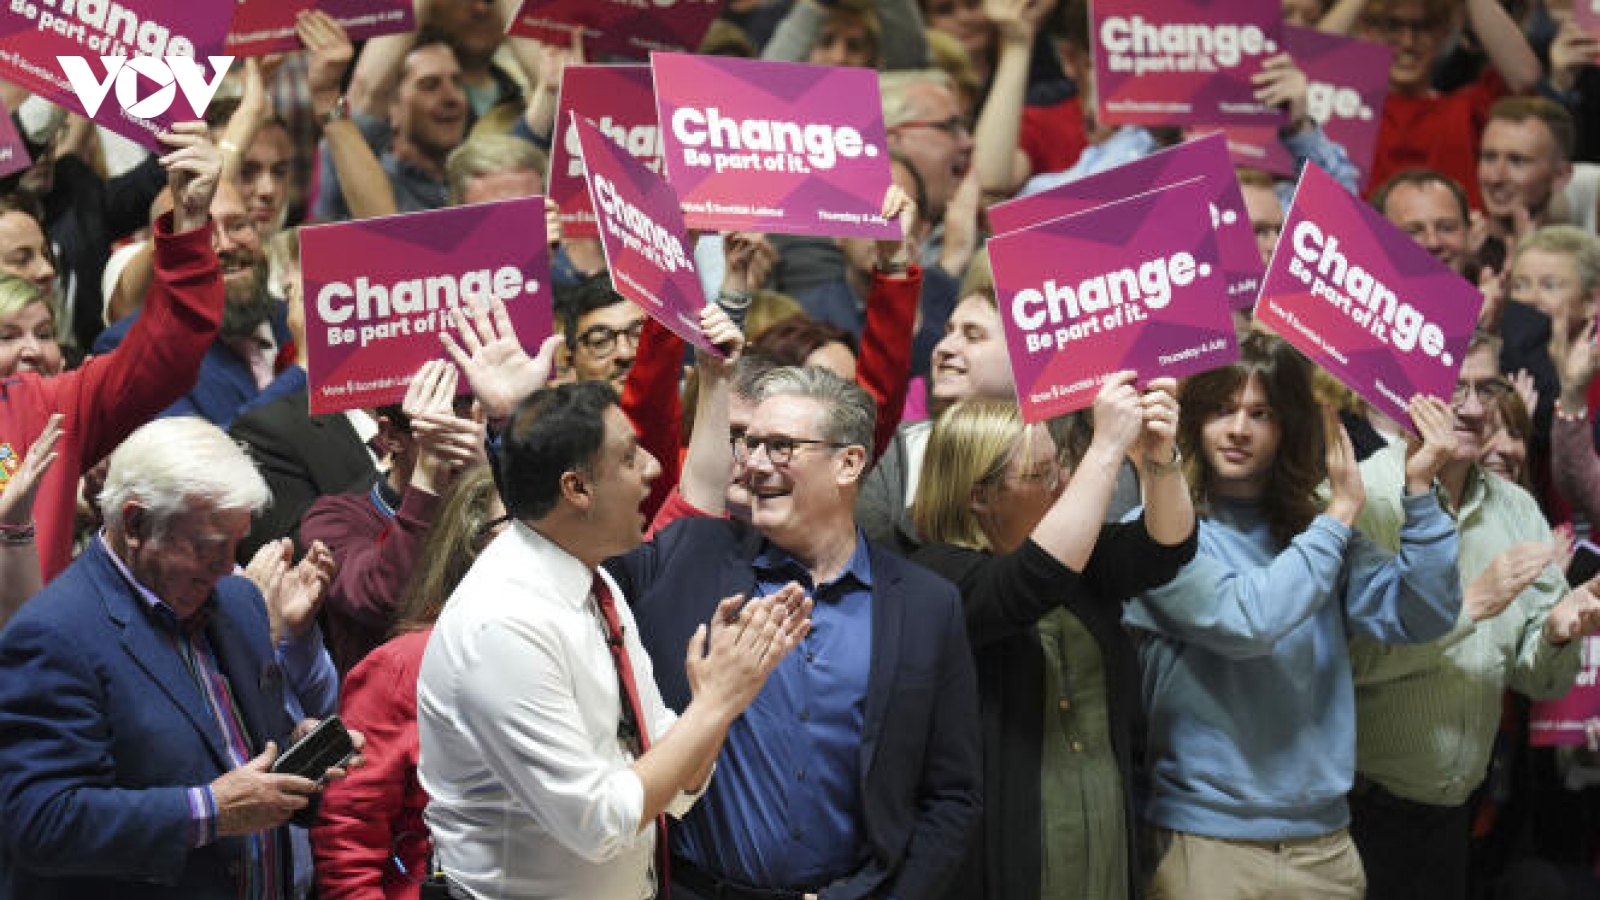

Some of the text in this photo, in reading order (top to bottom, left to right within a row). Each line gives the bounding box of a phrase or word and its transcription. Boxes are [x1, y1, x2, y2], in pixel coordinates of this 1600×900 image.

[1100, 15, 1278, 68] Change.
[672, 107, 879, 170] Change.
[684, 148, 711, 168] Be
[715, 151, 761, 174] part
[764, 152, 787, 171] of
[788, 154, 812, 174] it.
[594, 173, 695, 273] Change.
[317, 265, 540, 323] Change.
[1011, 251, 1213, 330] Change.
[1288, 256, 1390, 343] Be part of it.
[1293, 220, 1454, 367] Change.
[327, 307, 457, 348] Be part of it
[1025, 303, 1149, 353] Be part of it.
